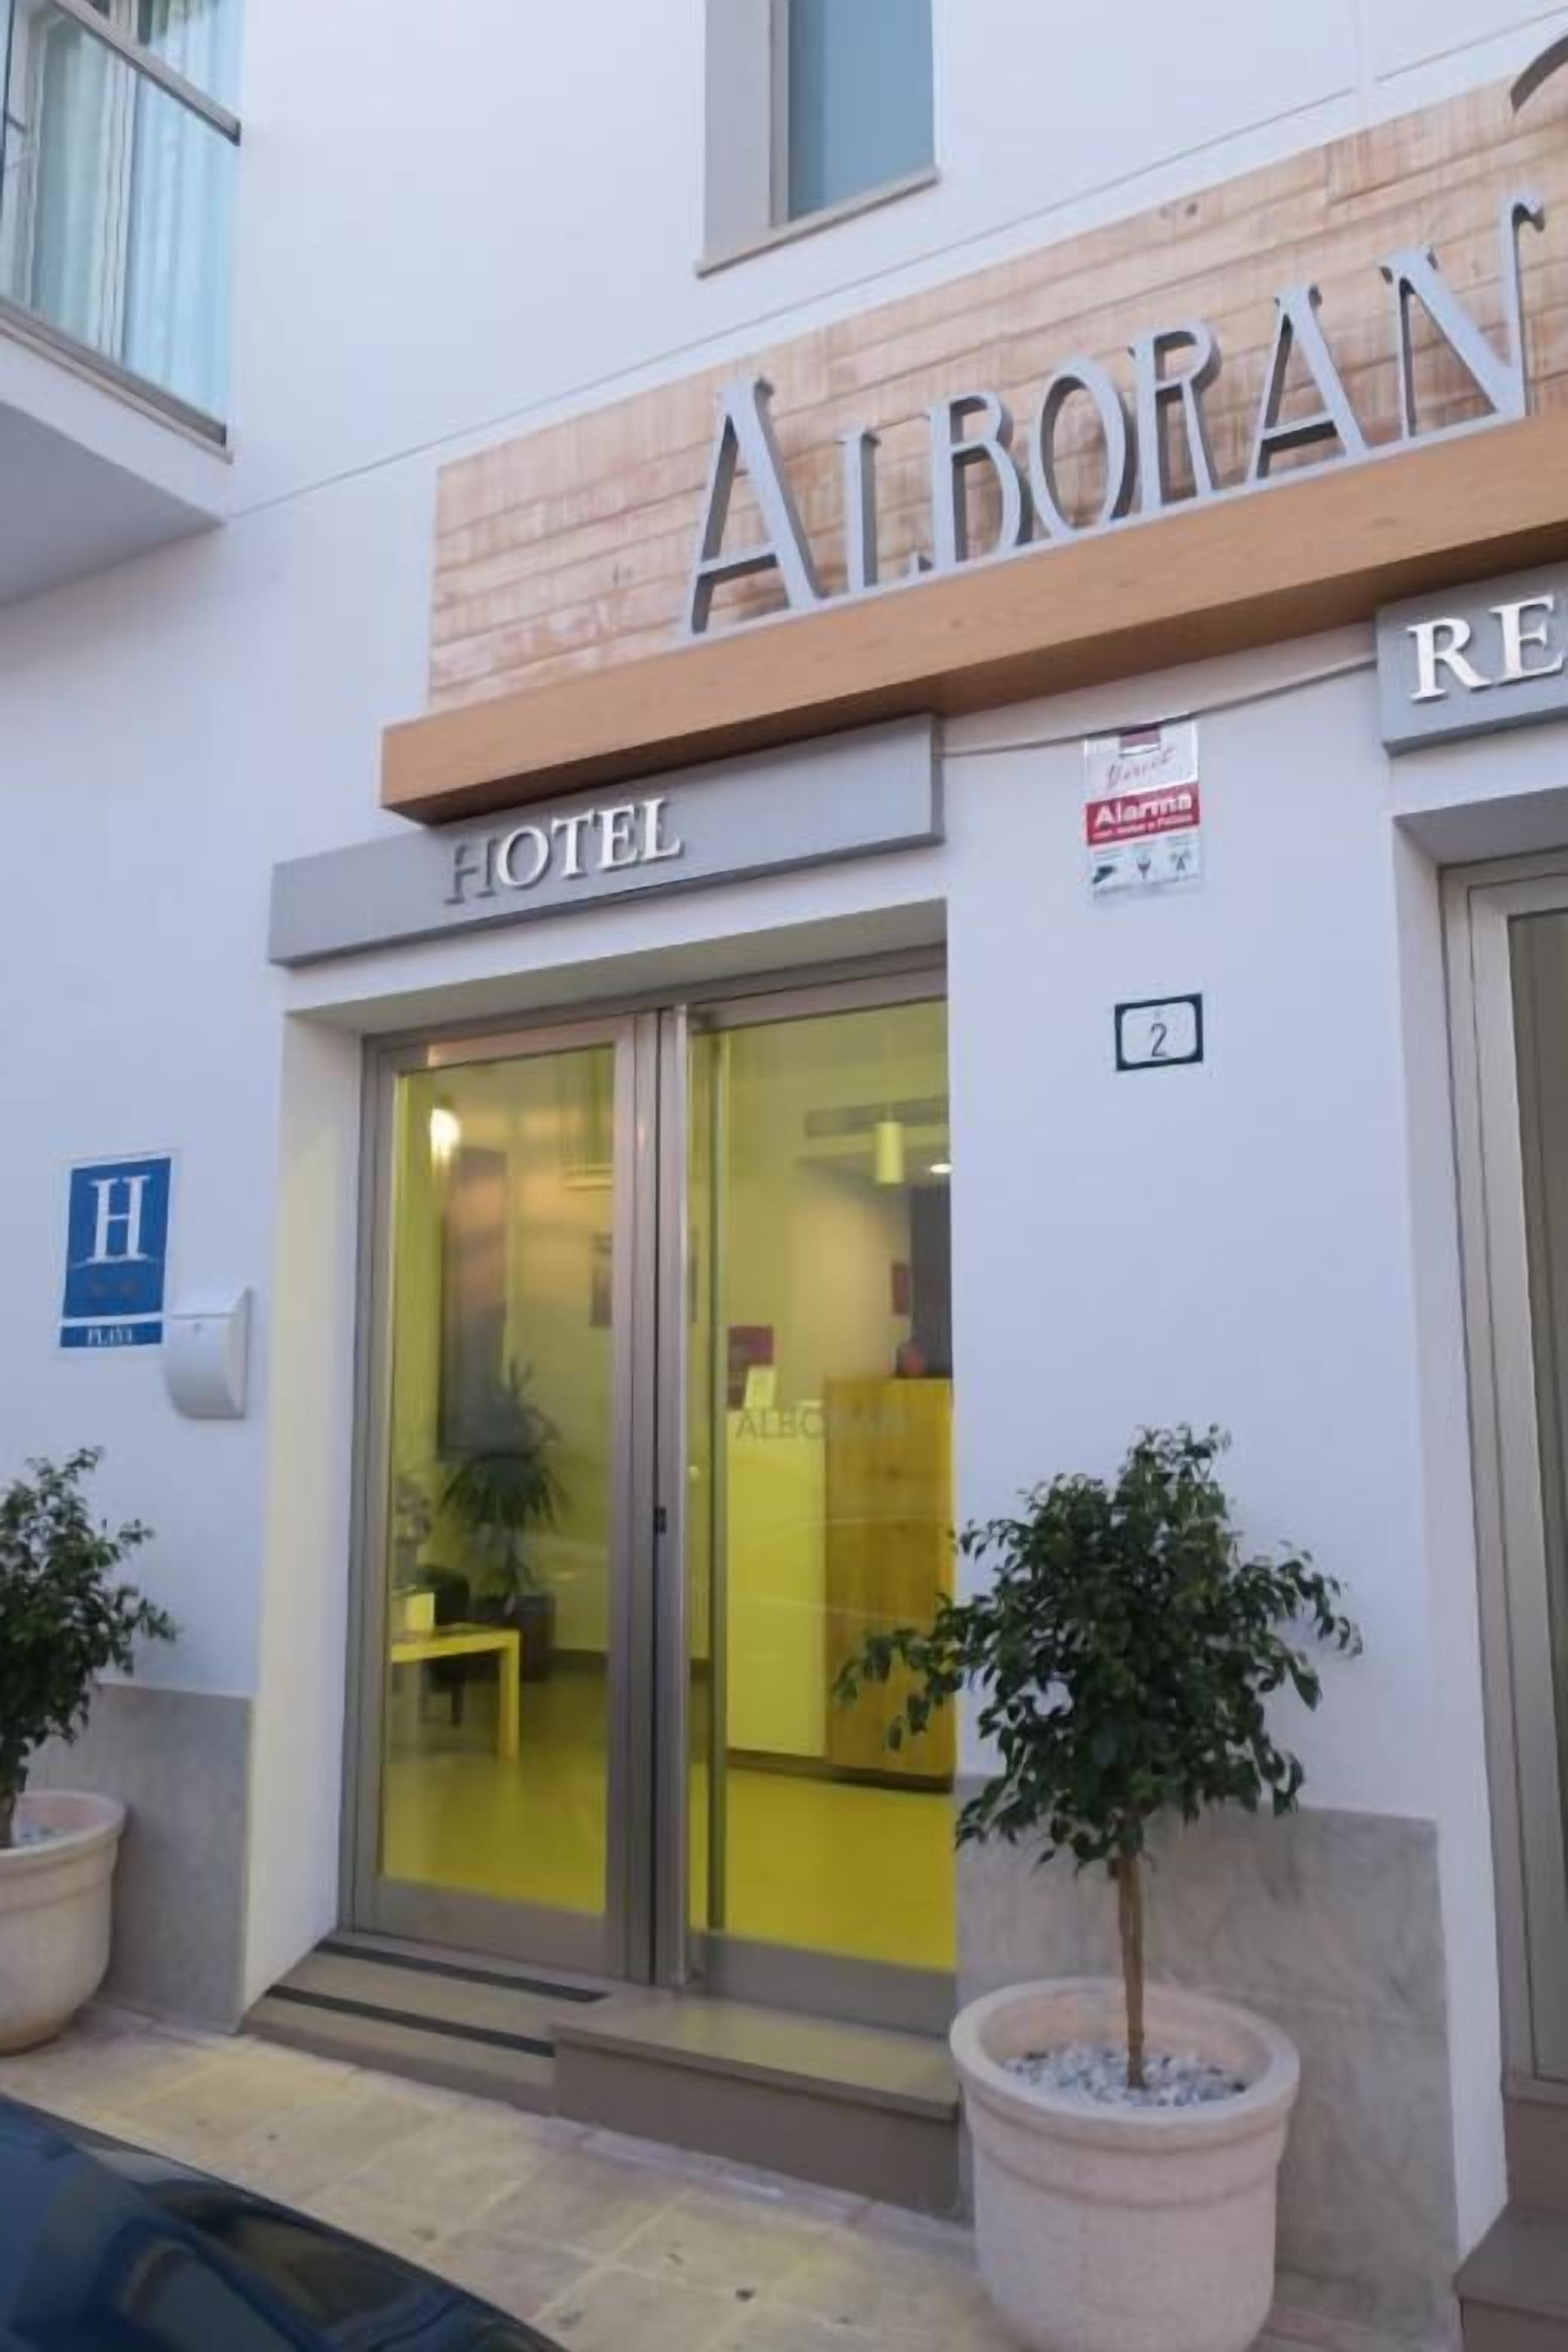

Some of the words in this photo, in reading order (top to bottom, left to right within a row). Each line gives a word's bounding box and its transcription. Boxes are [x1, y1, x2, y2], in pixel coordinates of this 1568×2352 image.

[685, 195, 1545, 635] ALBORAN
[1406, 593, 1563, 701] RE
[444, 796, 684, 905] HOTEL
[1094, 792, 1193, 829] Alarma
[1151, 1022, 1168, 1057] 2
[86, 1174, 151, 1263] H
